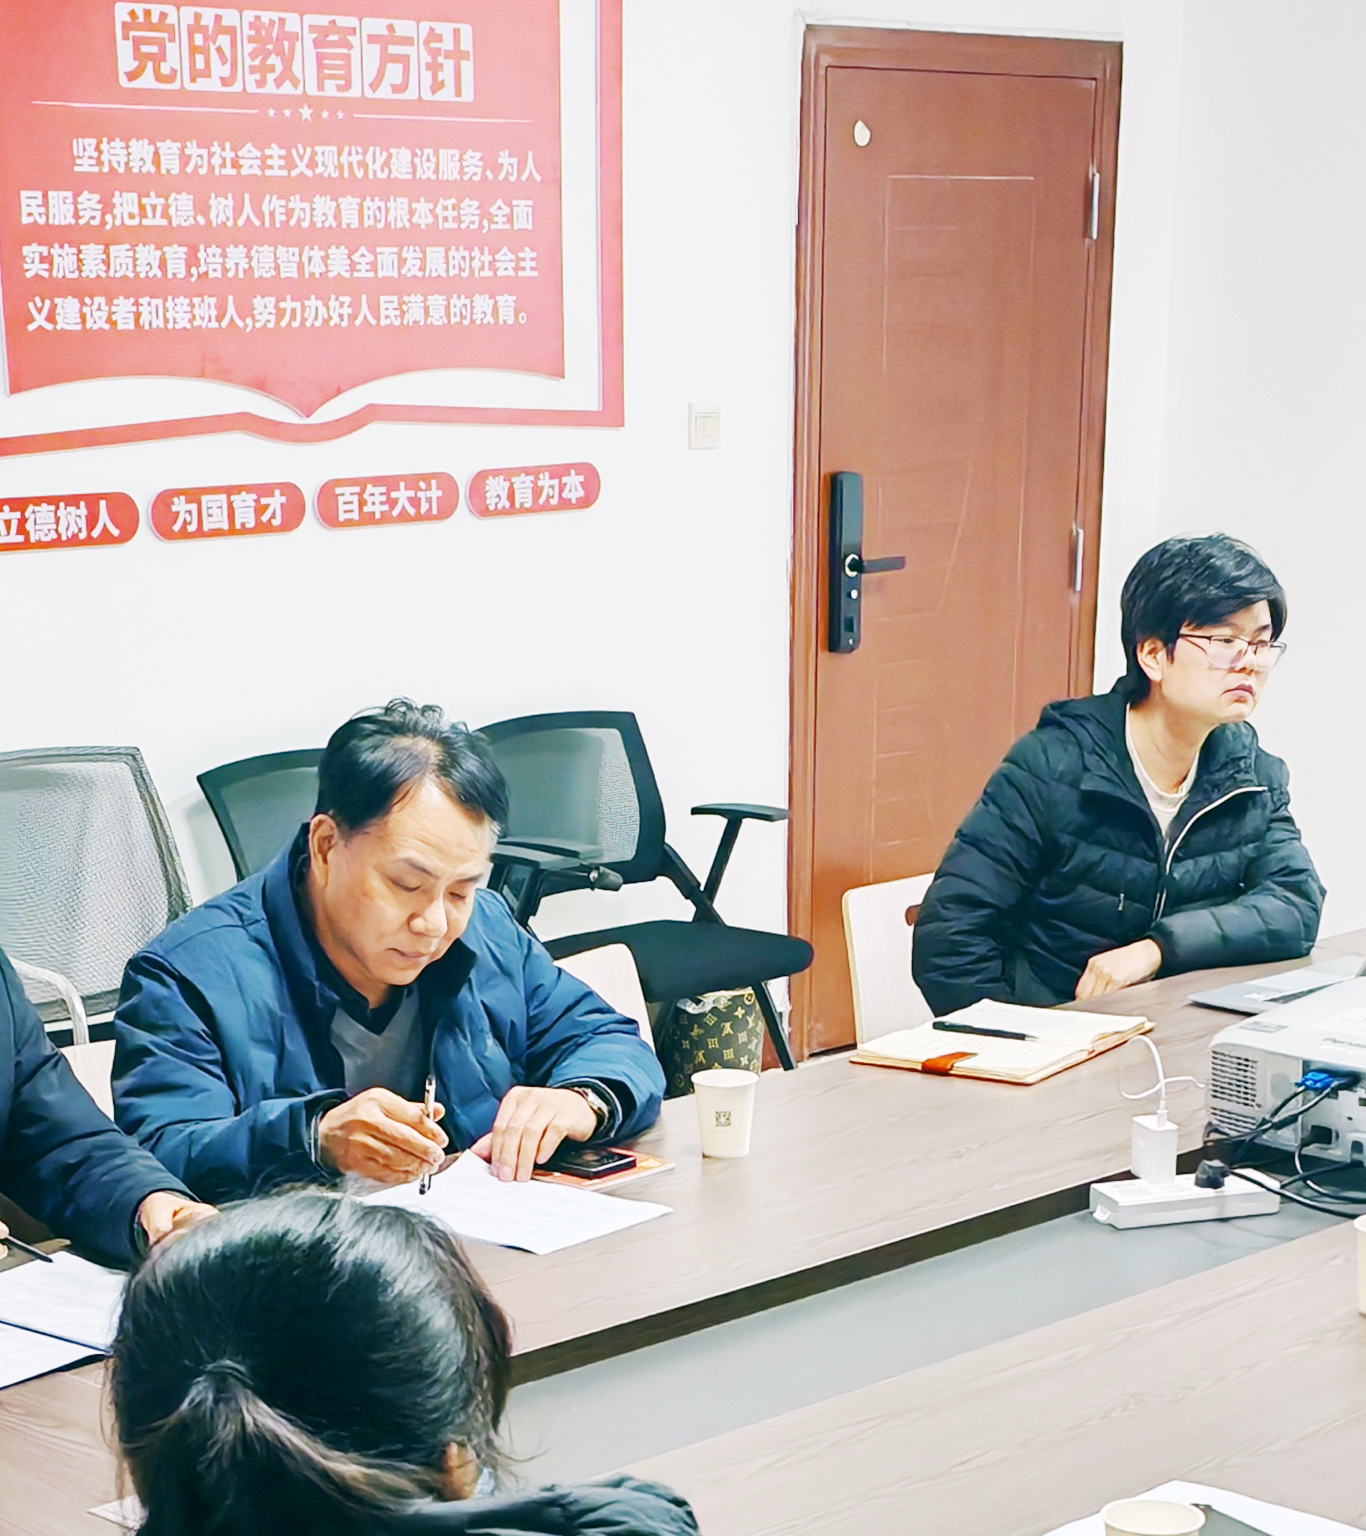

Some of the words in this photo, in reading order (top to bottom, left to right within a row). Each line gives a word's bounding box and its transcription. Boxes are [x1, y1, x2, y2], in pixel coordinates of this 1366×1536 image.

[120, 7, 471, 98] 党的教育方针
[72, 138, 542, 182] 坚持教育为社会主义现代化建设服务、为人
[171, 489, 286, 533] 为国育才
[336, 479, 443, 522] 百年大计
[485, 469, 585, 511] 教育为本
